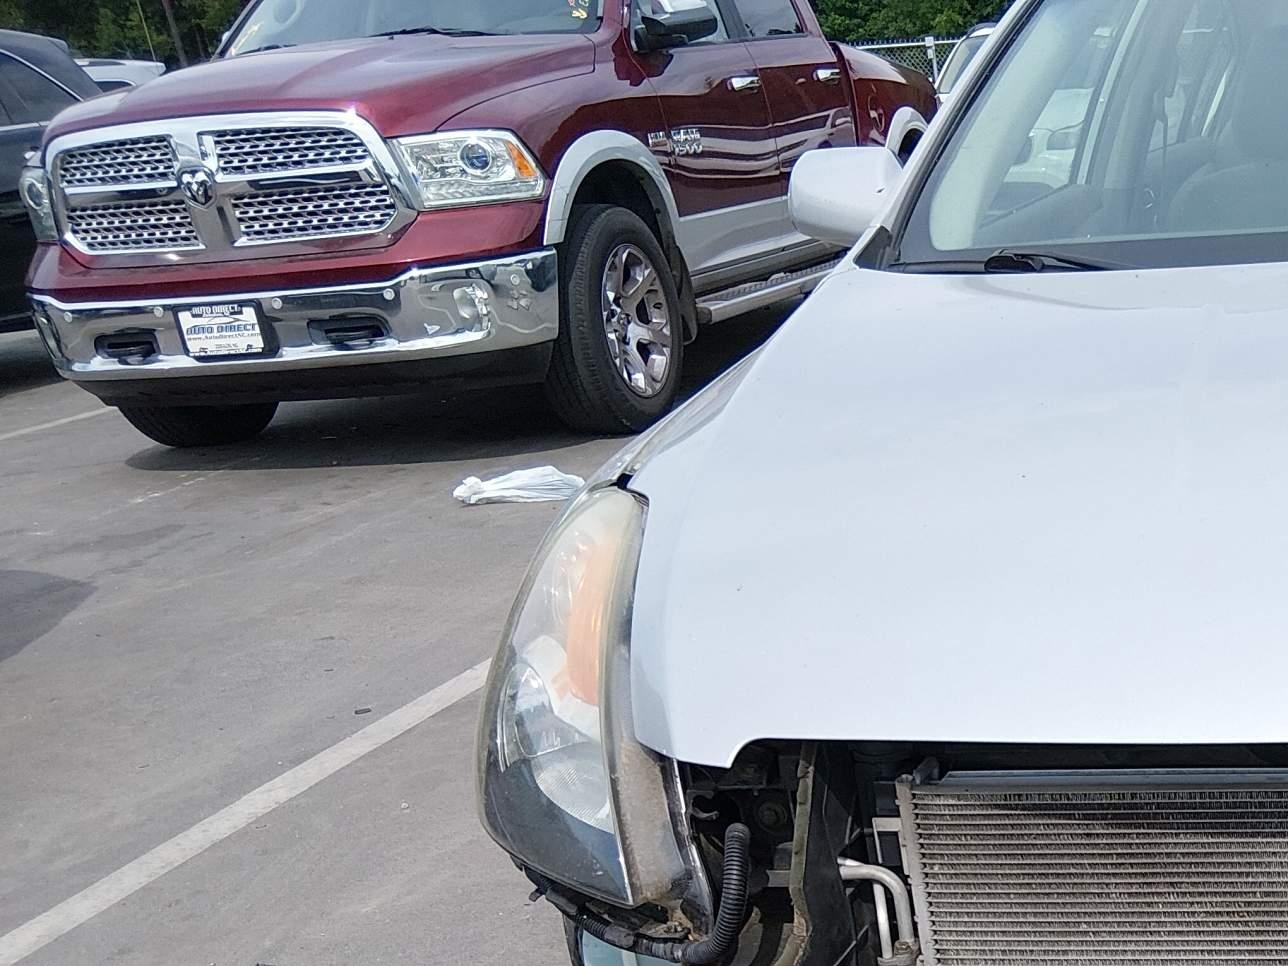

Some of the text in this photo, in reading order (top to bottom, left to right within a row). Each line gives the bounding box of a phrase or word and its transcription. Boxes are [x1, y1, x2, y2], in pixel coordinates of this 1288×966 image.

[191, 305, 212, 315] AUTO
[186, 323, 257, 336] AUTO DIRECT
